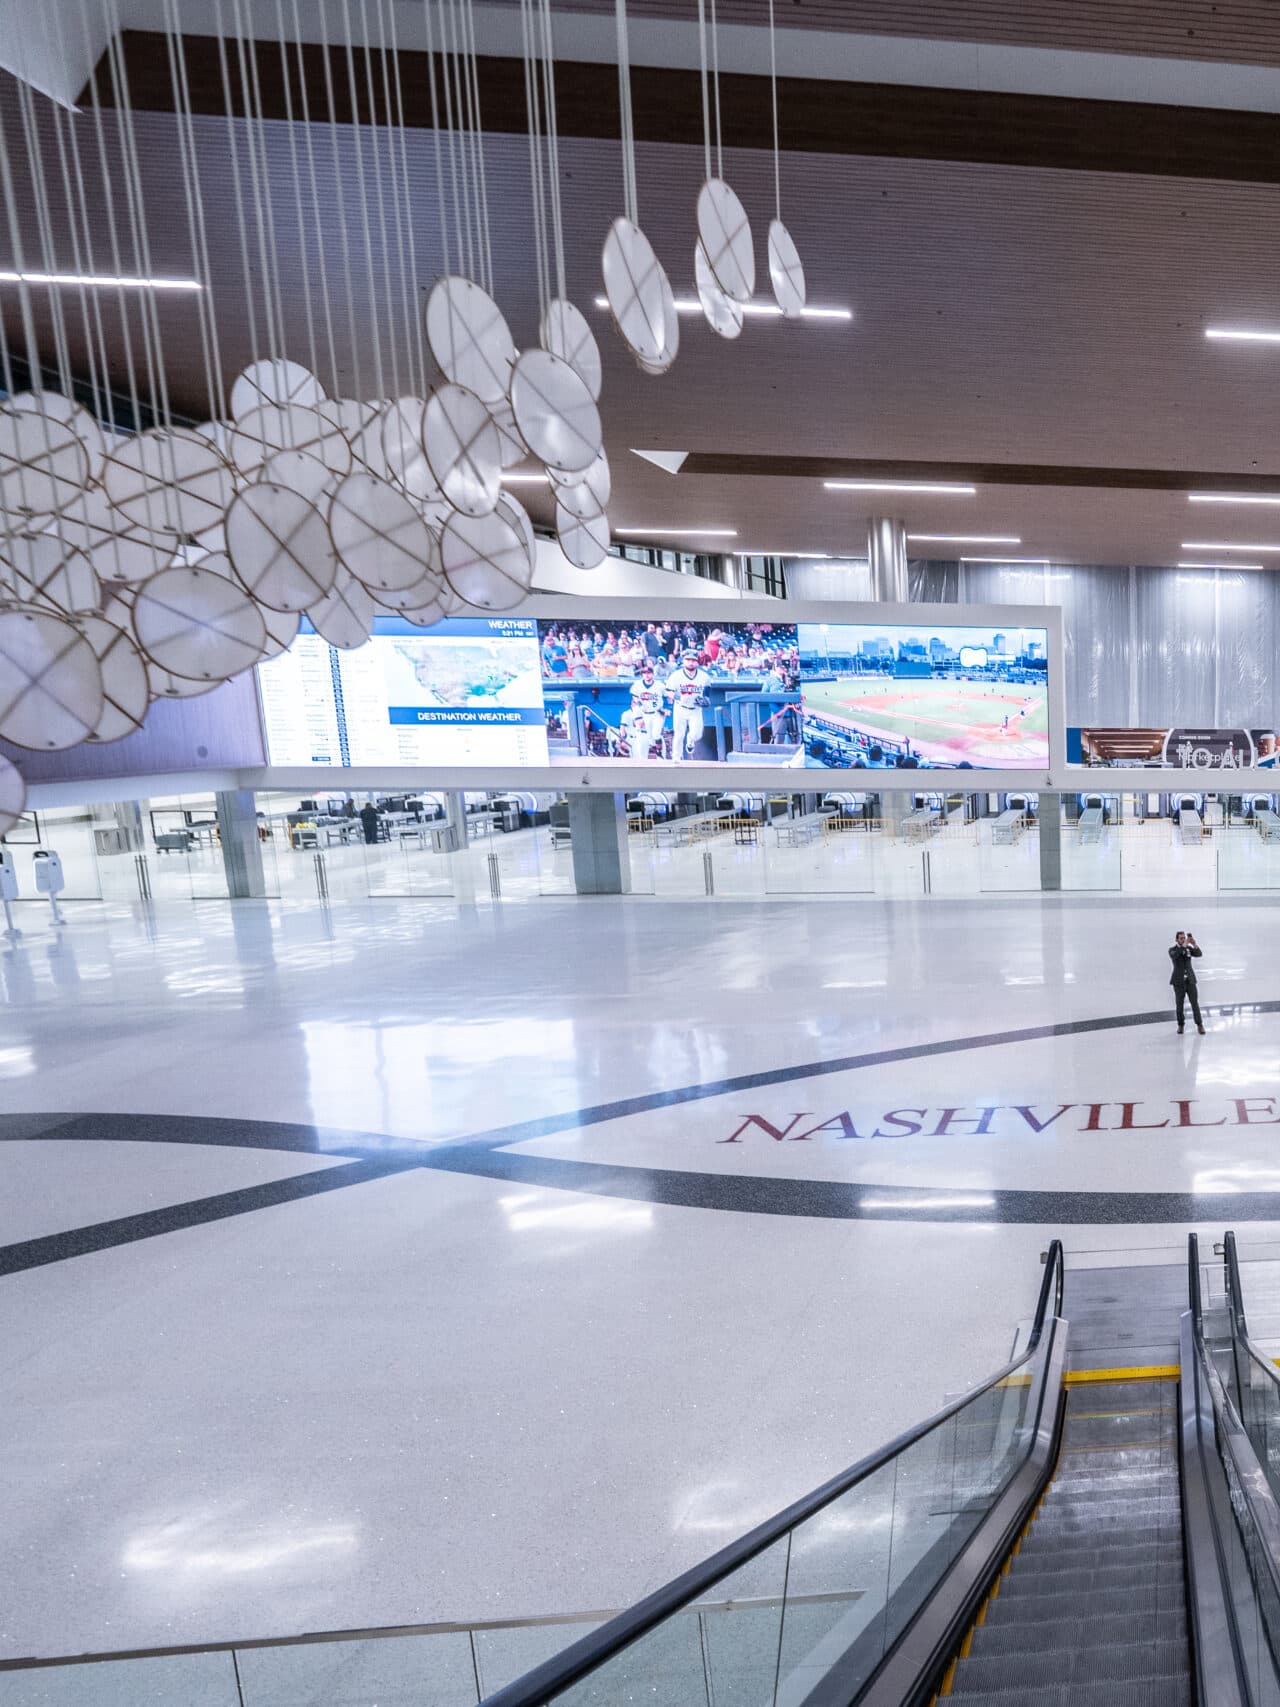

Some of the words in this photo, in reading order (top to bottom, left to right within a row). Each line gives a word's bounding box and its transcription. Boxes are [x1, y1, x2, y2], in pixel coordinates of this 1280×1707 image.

[488, 619, 533, 629] WEATHER
[417, 712, 476, 721] DESTINATION
[477, 712, 521, 721] WEATHER
[1178, 751, 1241, 763] Mrketplae
